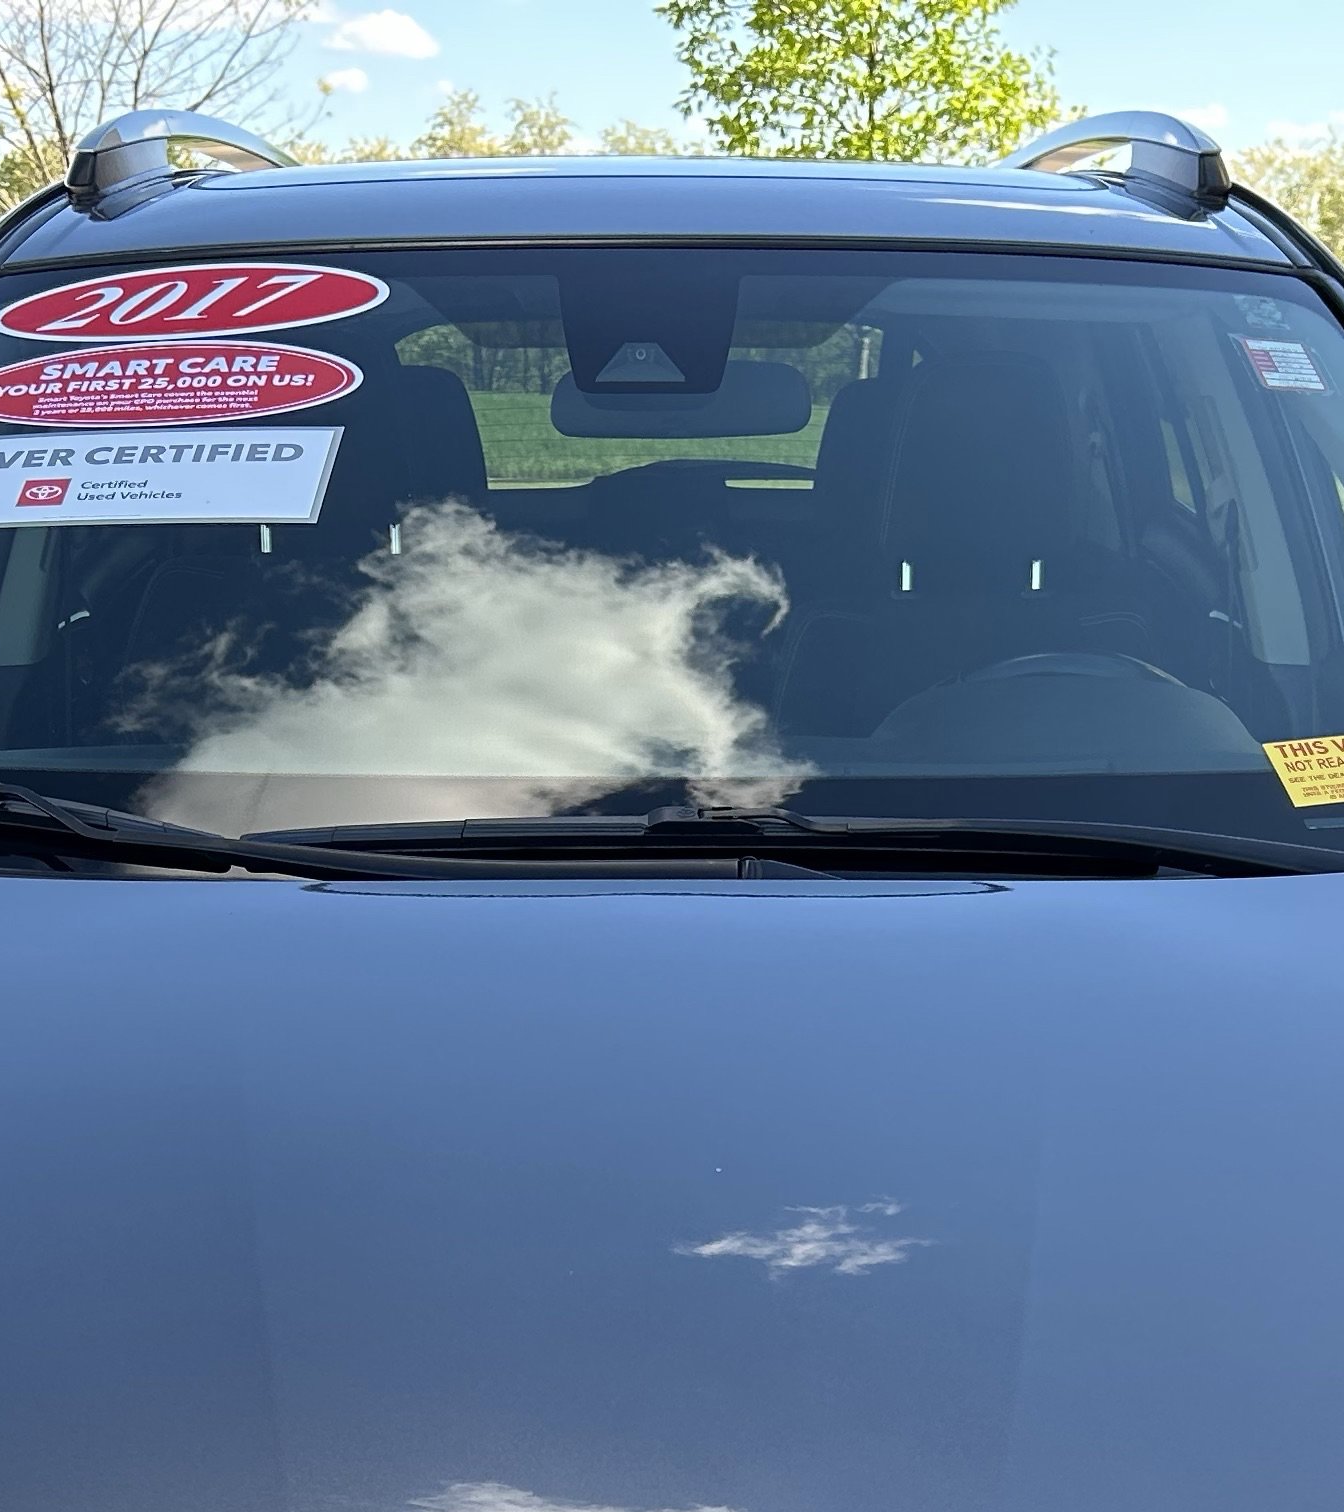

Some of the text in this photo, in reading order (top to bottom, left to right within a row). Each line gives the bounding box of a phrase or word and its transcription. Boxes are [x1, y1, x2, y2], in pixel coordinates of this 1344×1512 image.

[36, 273, 324, 332] 2017
[39, 354, 281, 381] SMART CARE
[67, 378, 137, 394] FIRST
[138, 374, 224, 393] 25,000
[225, 373, 266, 388] ON
[271, 373, 316, 387] US!
[84, 442, 305, 466] CERTIFIED
[79, 478, 148, 490] Certified
[76, 489, 183, 501] Used Vehicles
[1274, 740, 1329, 759] THIS
[1283, 759, 1314, 773] NOT
